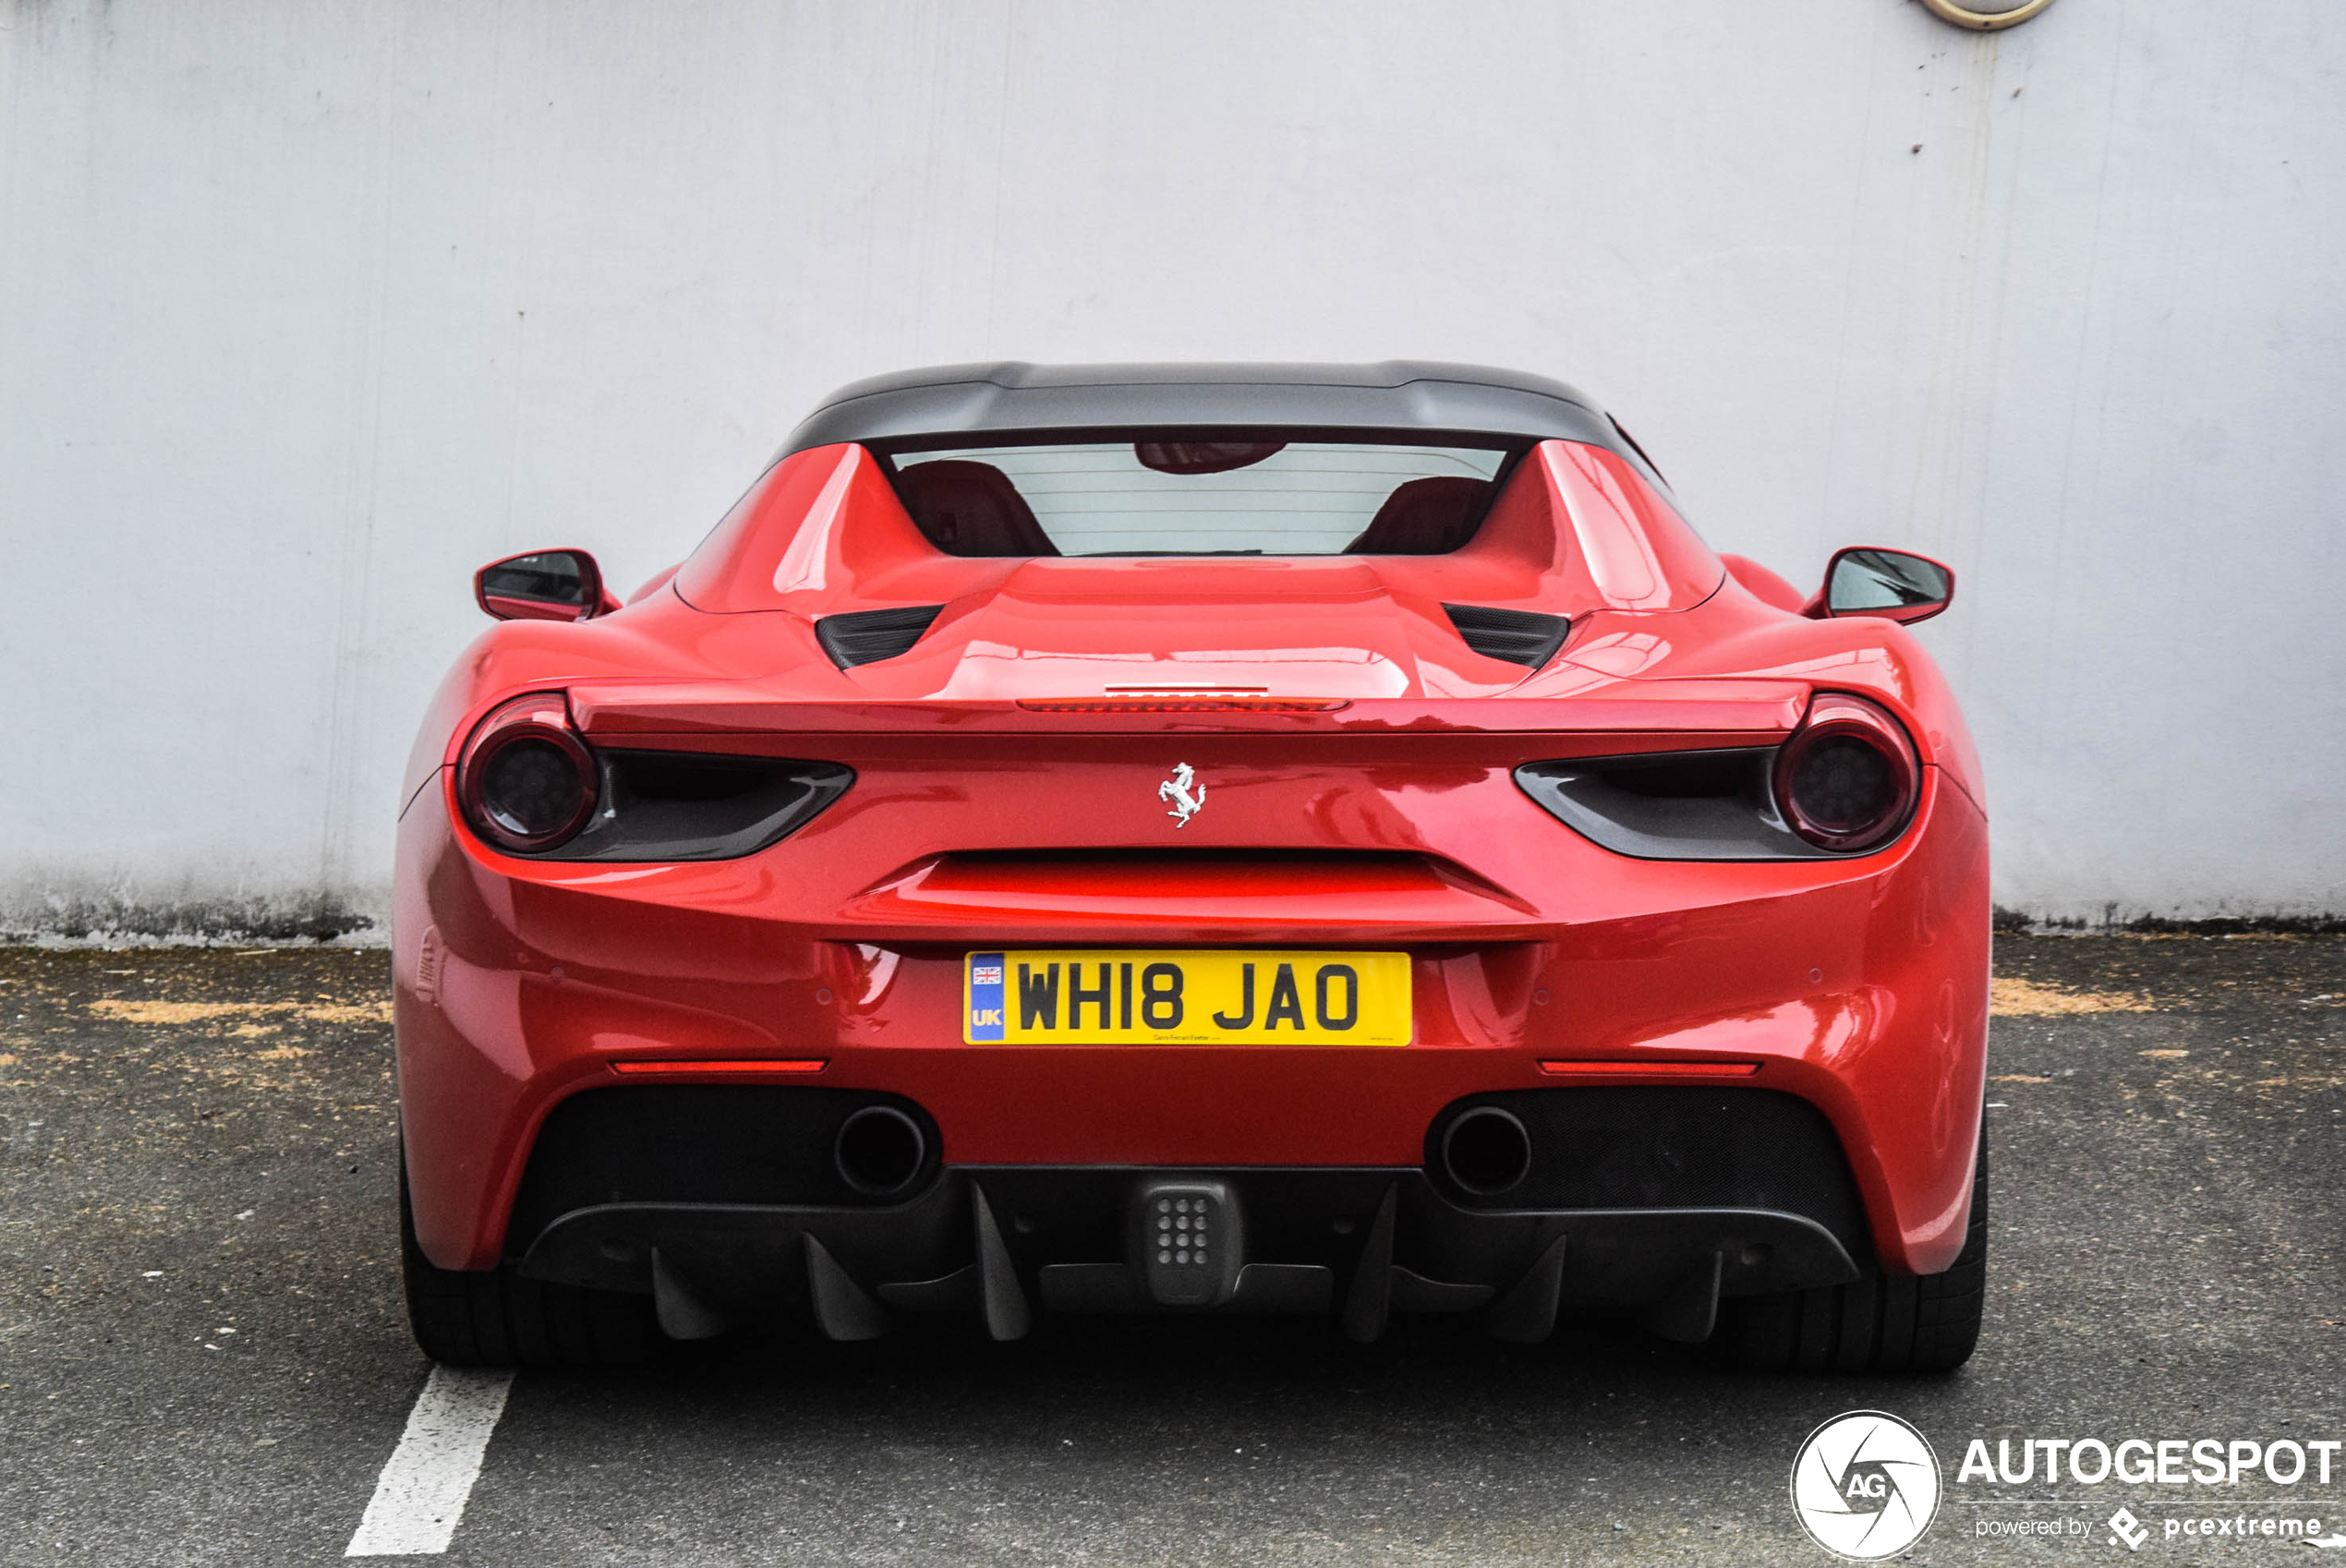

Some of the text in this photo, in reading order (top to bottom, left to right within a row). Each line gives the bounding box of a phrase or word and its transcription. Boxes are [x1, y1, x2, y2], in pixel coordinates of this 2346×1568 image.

[973, 1009, 1002, 1026] UK
[1018, 962, 1359, 1031] WH18 JAO
